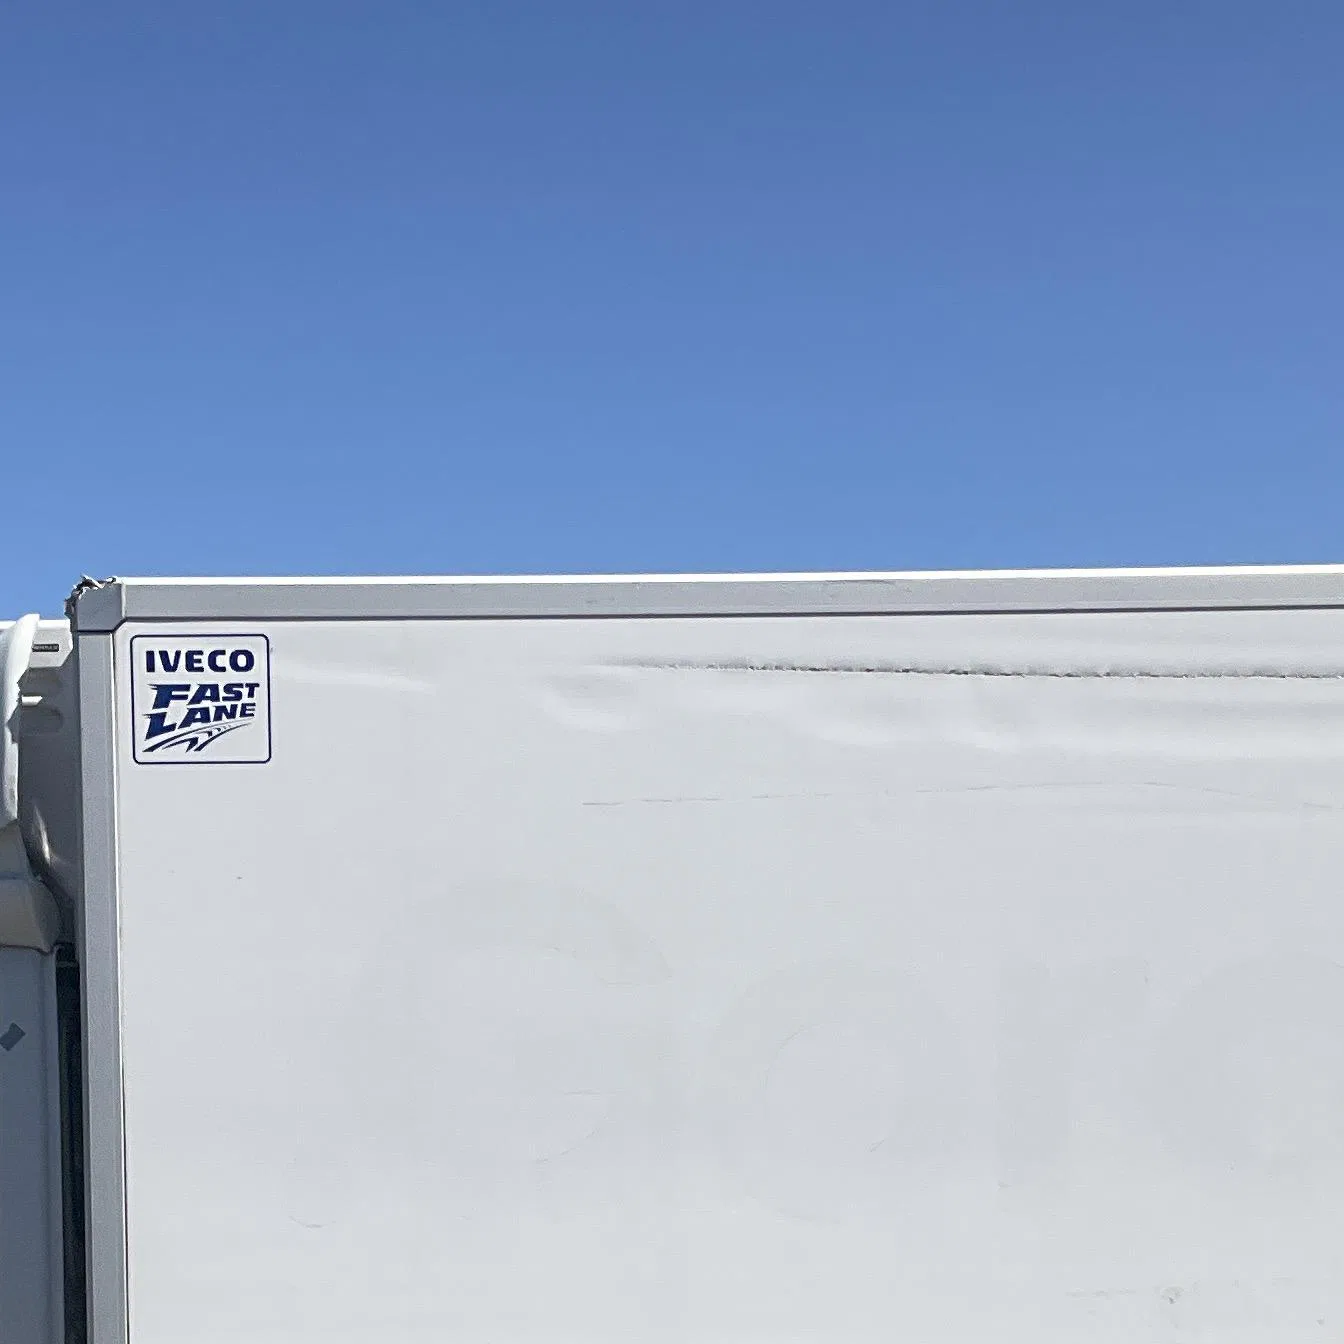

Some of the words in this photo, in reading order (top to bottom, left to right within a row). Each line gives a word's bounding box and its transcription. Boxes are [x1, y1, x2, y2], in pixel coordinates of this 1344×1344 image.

[146, 649, 255, 672] IVECO
[147, 682, 260, 710] FAST
[142, 702, 256, 741] LANE
